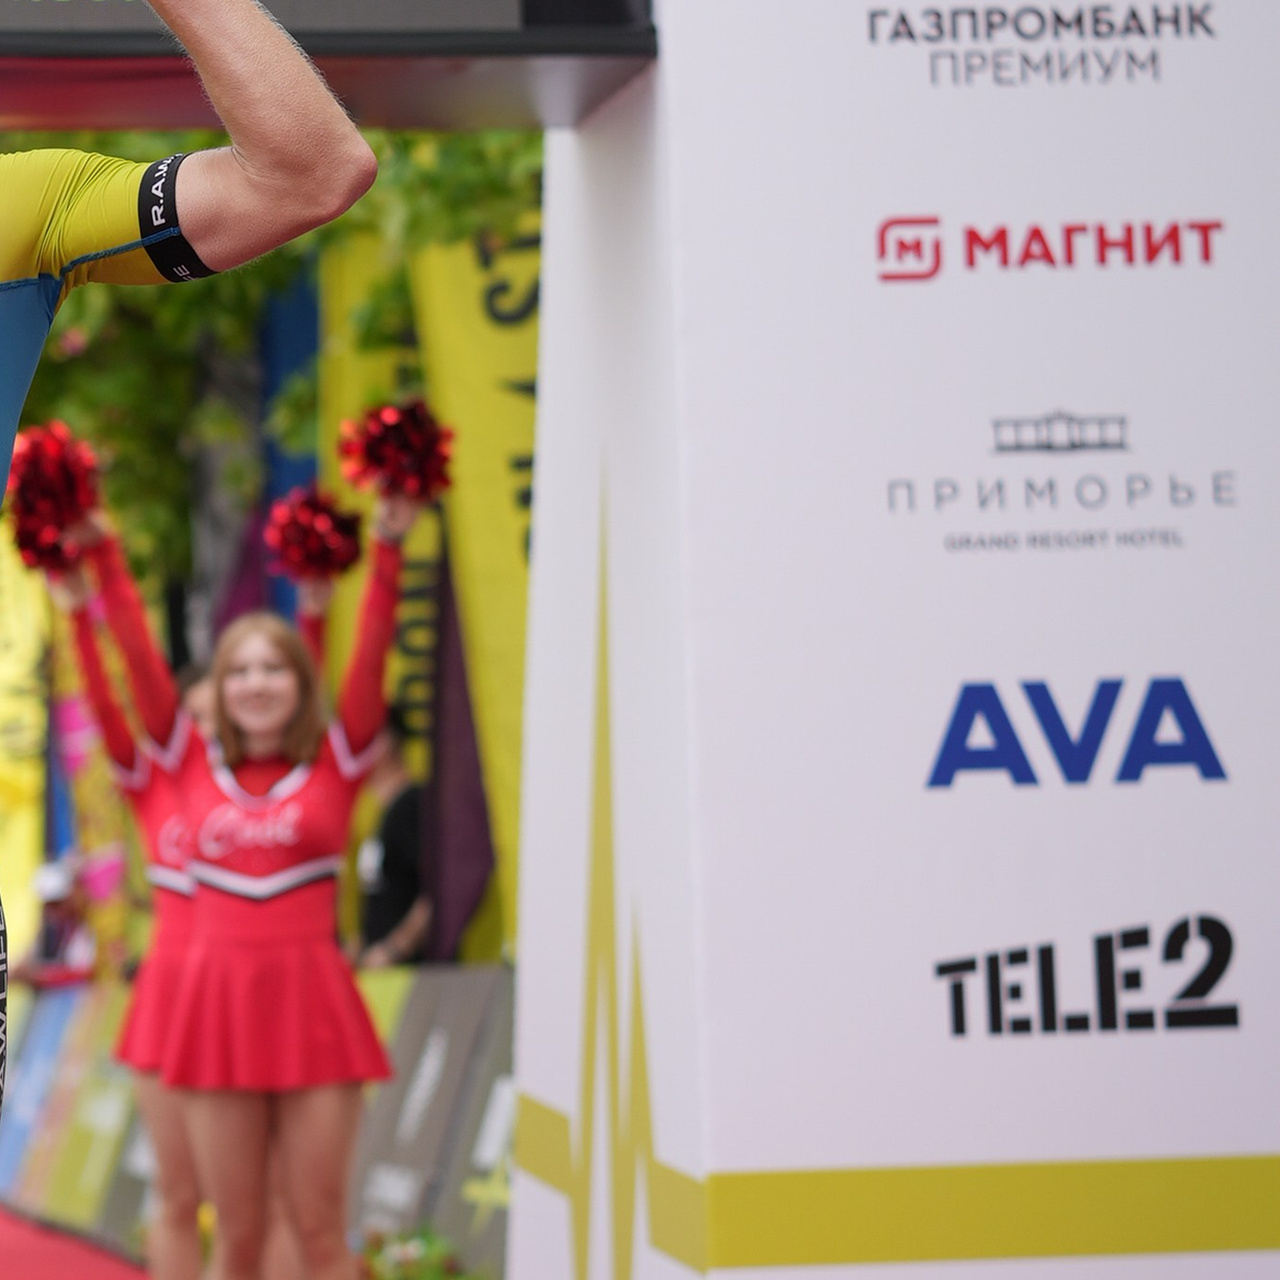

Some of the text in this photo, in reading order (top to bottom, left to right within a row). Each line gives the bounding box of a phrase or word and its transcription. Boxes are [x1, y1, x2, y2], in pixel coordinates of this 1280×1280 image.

[865, 0, 1217, 45] ГАЗПРОМБАНК
[928, 47, 1164, 88] ПРЕМИУМ
[962, 220, 1225, 270] МАГНИТ
[885, 470, 1240, 514] ПРИМОРЬЕ
[924, 676, 1229, 789] AVA
[933, 914, 1240, 1037] TELE2
